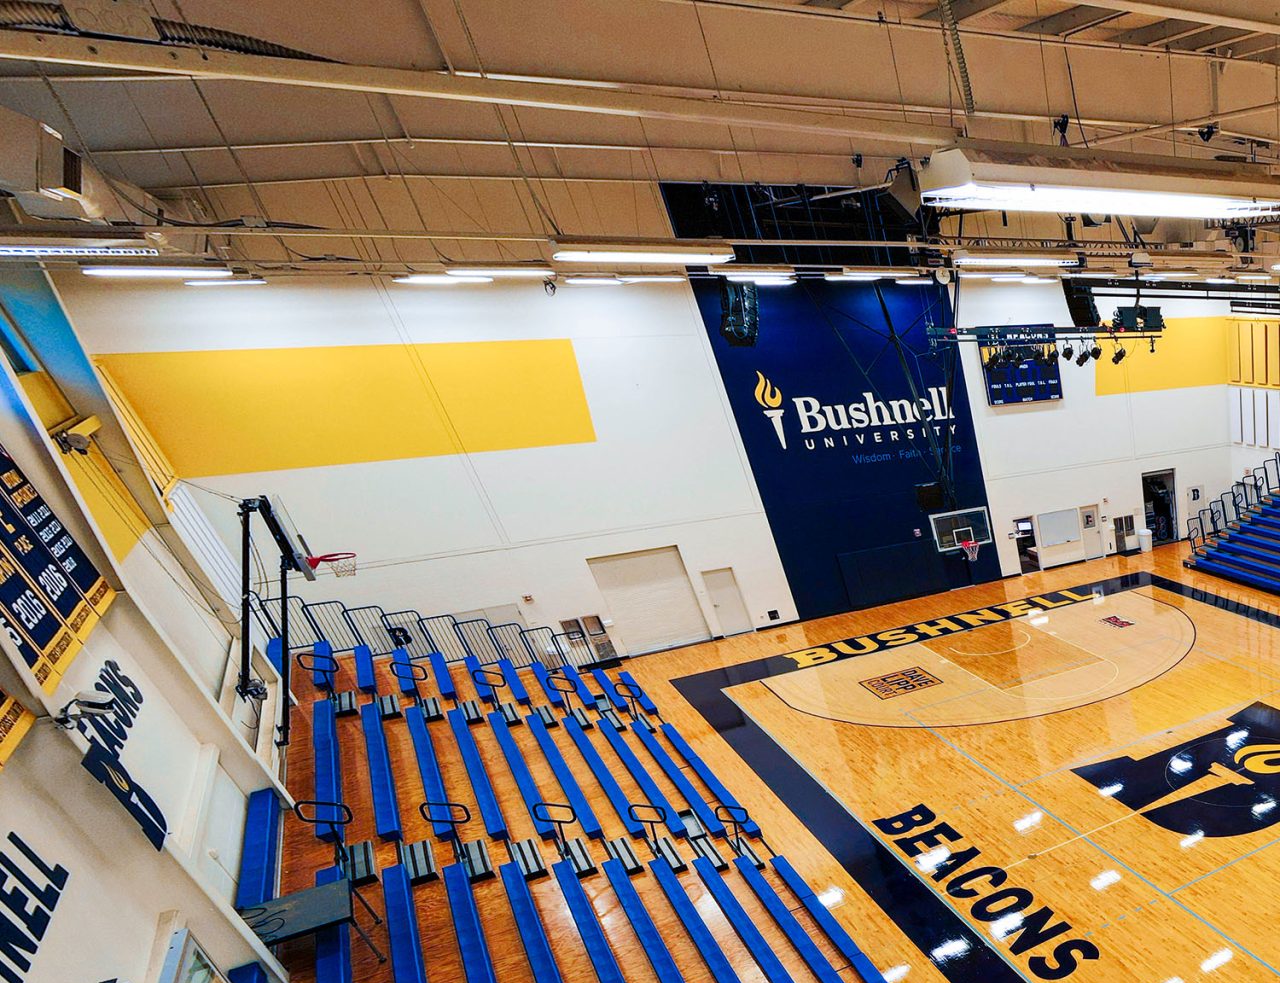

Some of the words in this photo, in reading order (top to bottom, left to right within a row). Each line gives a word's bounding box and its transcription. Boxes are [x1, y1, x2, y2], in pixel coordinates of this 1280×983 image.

[792, 387, 955, 433] Bushnell
[805, 425, 957, 450] UNIVERSITY
[852, 452, 892, 464] Wisdom
[38, 564, 68, 602] 2016
[11, 589, 47, 631] 2016
[785, 588, 1100, 668] BUSHNELL
[881, 673, 916, 691] LIPP
[901, 669, 934, 687] DAVE
[872, 803, 1100, 981] BEACONS
